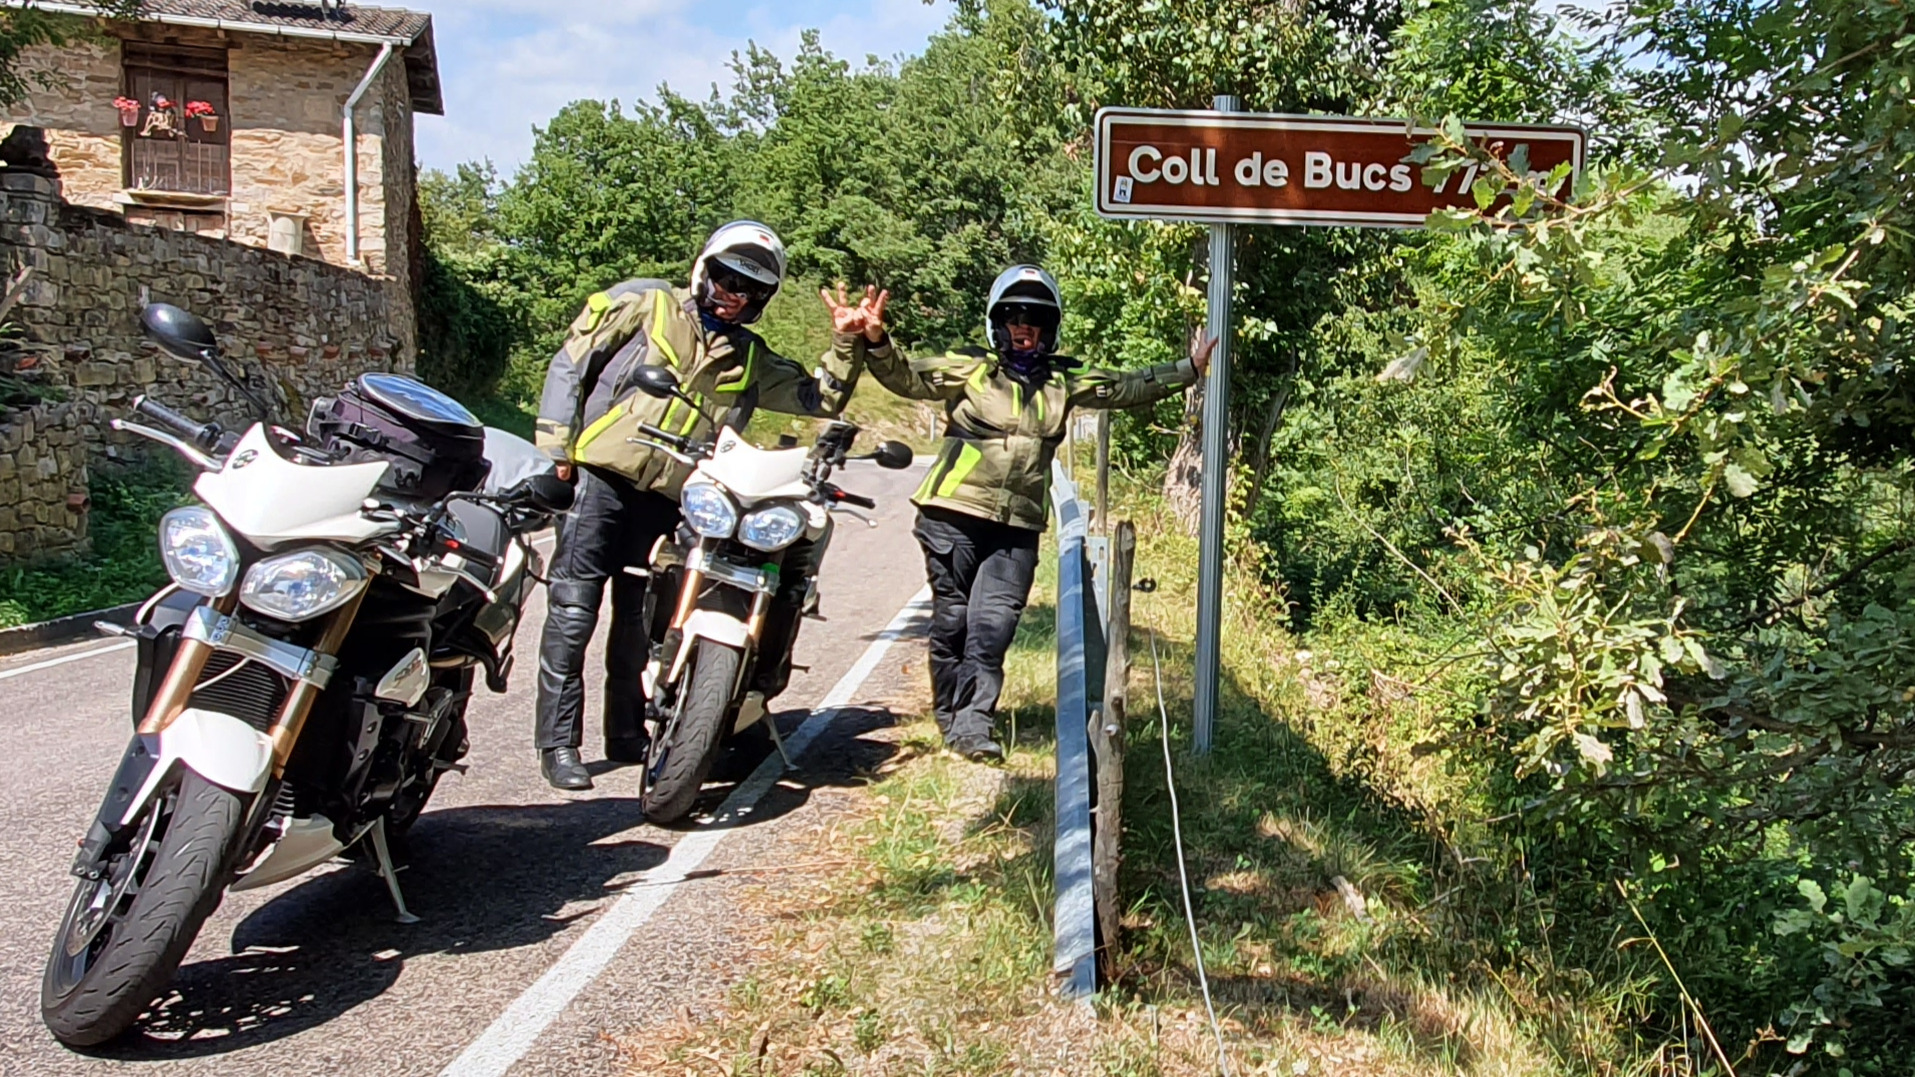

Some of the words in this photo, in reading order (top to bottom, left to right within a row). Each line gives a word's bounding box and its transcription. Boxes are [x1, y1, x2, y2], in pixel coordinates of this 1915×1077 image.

[1128, 146, 1219, 186] Coll
[1234, 152, 1289, 186] de
[1304, 152, 1411, 191] Bucs
